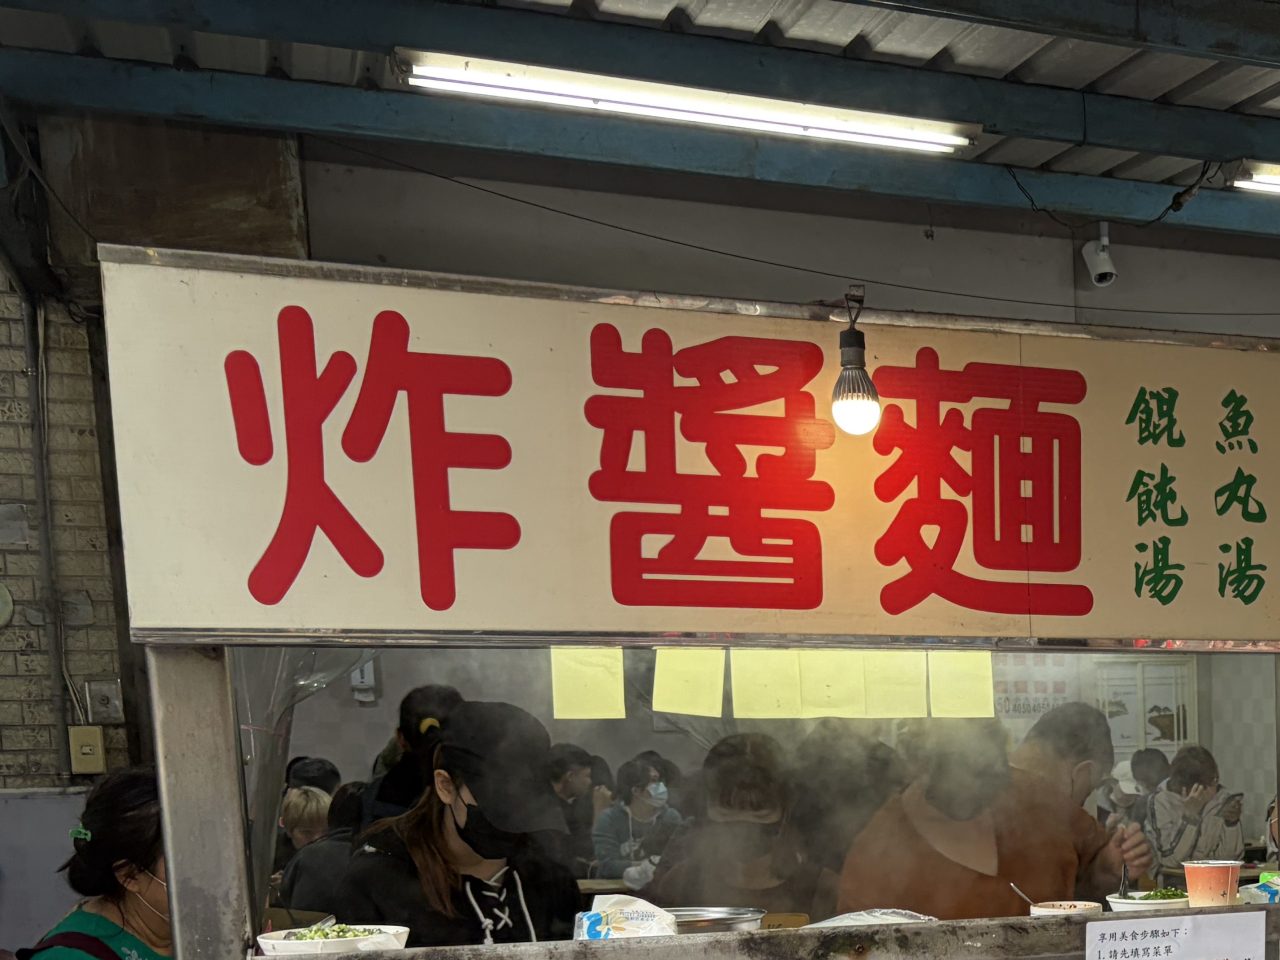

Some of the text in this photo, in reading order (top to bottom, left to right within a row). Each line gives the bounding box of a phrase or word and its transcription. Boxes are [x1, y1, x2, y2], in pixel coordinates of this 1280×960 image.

[224, 305, 1094, 616] 炸醬麵
[1125, 386, 1189, 606] 餛飩湯
[1214, 388, 1268, 606] 魚丸湯
